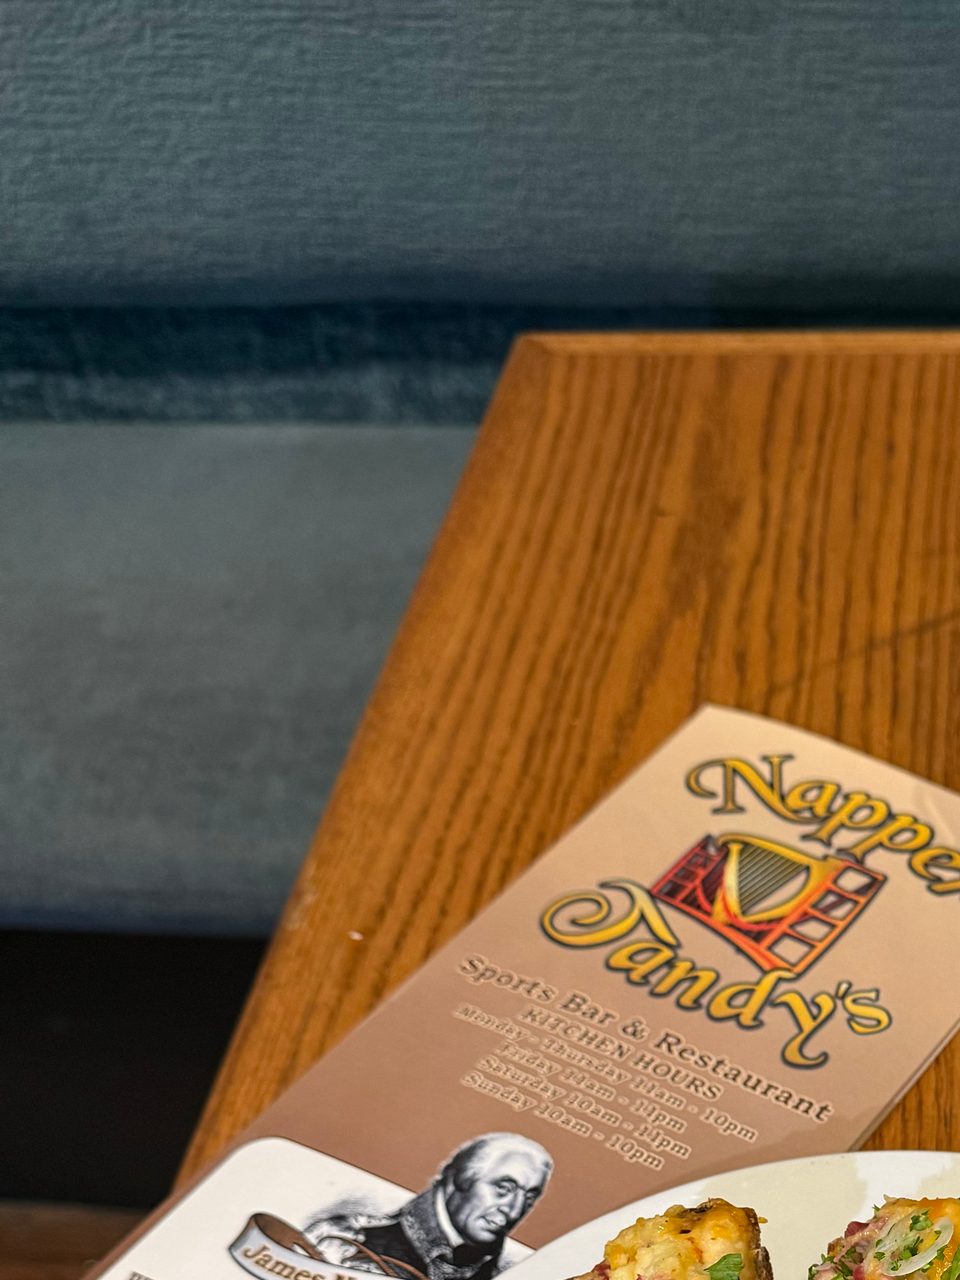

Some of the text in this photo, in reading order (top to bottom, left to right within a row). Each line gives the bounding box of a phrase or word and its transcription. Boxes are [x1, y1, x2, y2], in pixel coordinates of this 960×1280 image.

[540, 878, 893, 1070] Tandy's
[458, 954, 835, 1120] Sports Bar & Restaurant
[524, 1007, 721, 1098] KITCHEN HOURS
[461, 1072, 536, 1112] Sunday
[605, 1135, 667, 1170] 10pm
[700, 1109, 759, 1142] 10pm
